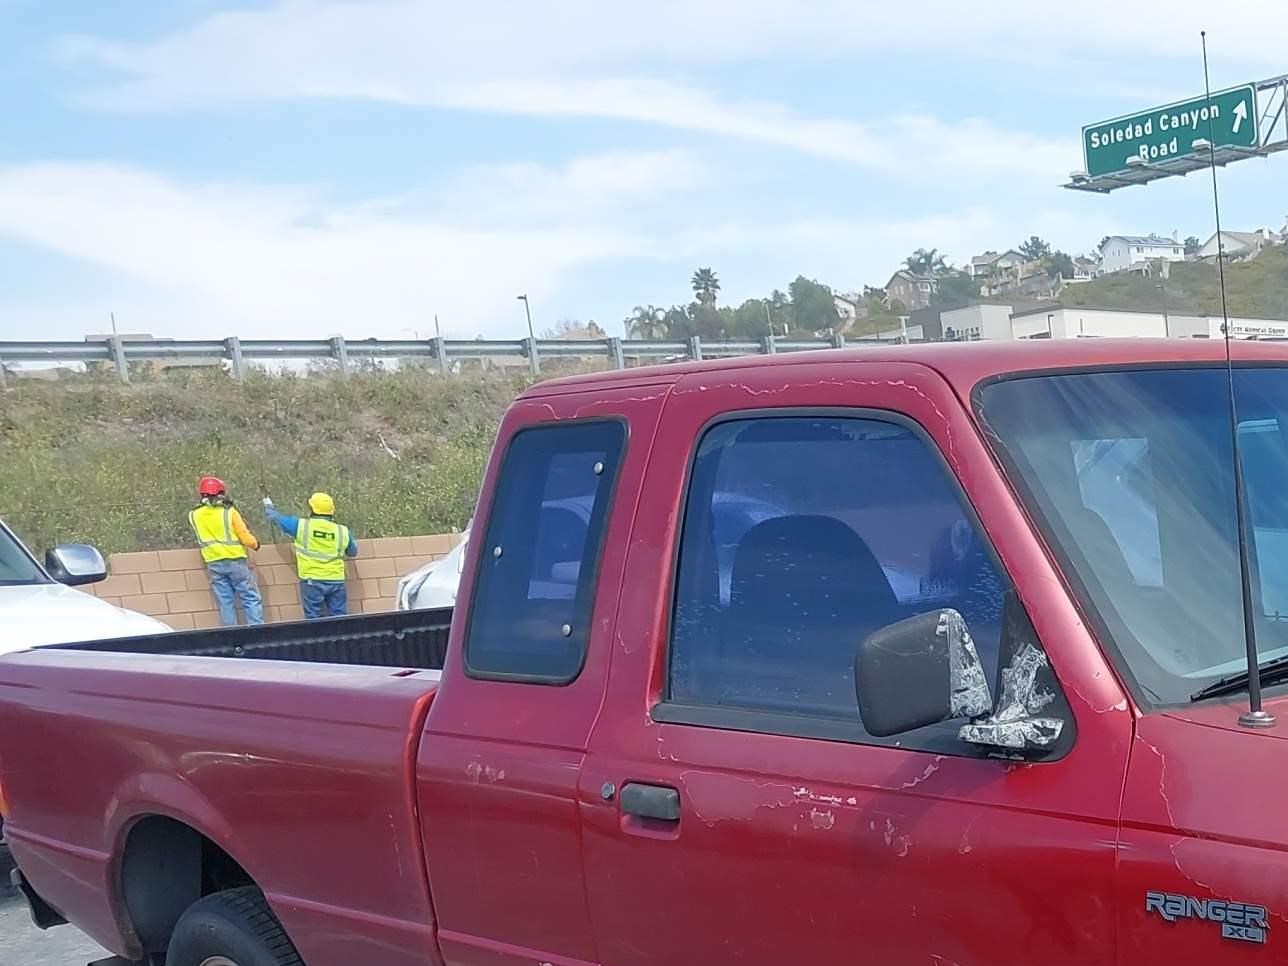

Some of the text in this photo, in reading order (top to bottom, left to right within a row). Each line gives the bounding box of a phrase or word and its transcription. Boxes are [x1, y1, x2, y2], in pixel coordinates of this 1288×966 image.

[1091, 105, 1219, 148] Soledad Canyon
[1140, 137, 1177, 160] Road
[1145, 890, 1272, 930] RANGER
[1227, 927, 1258, 940] XL
